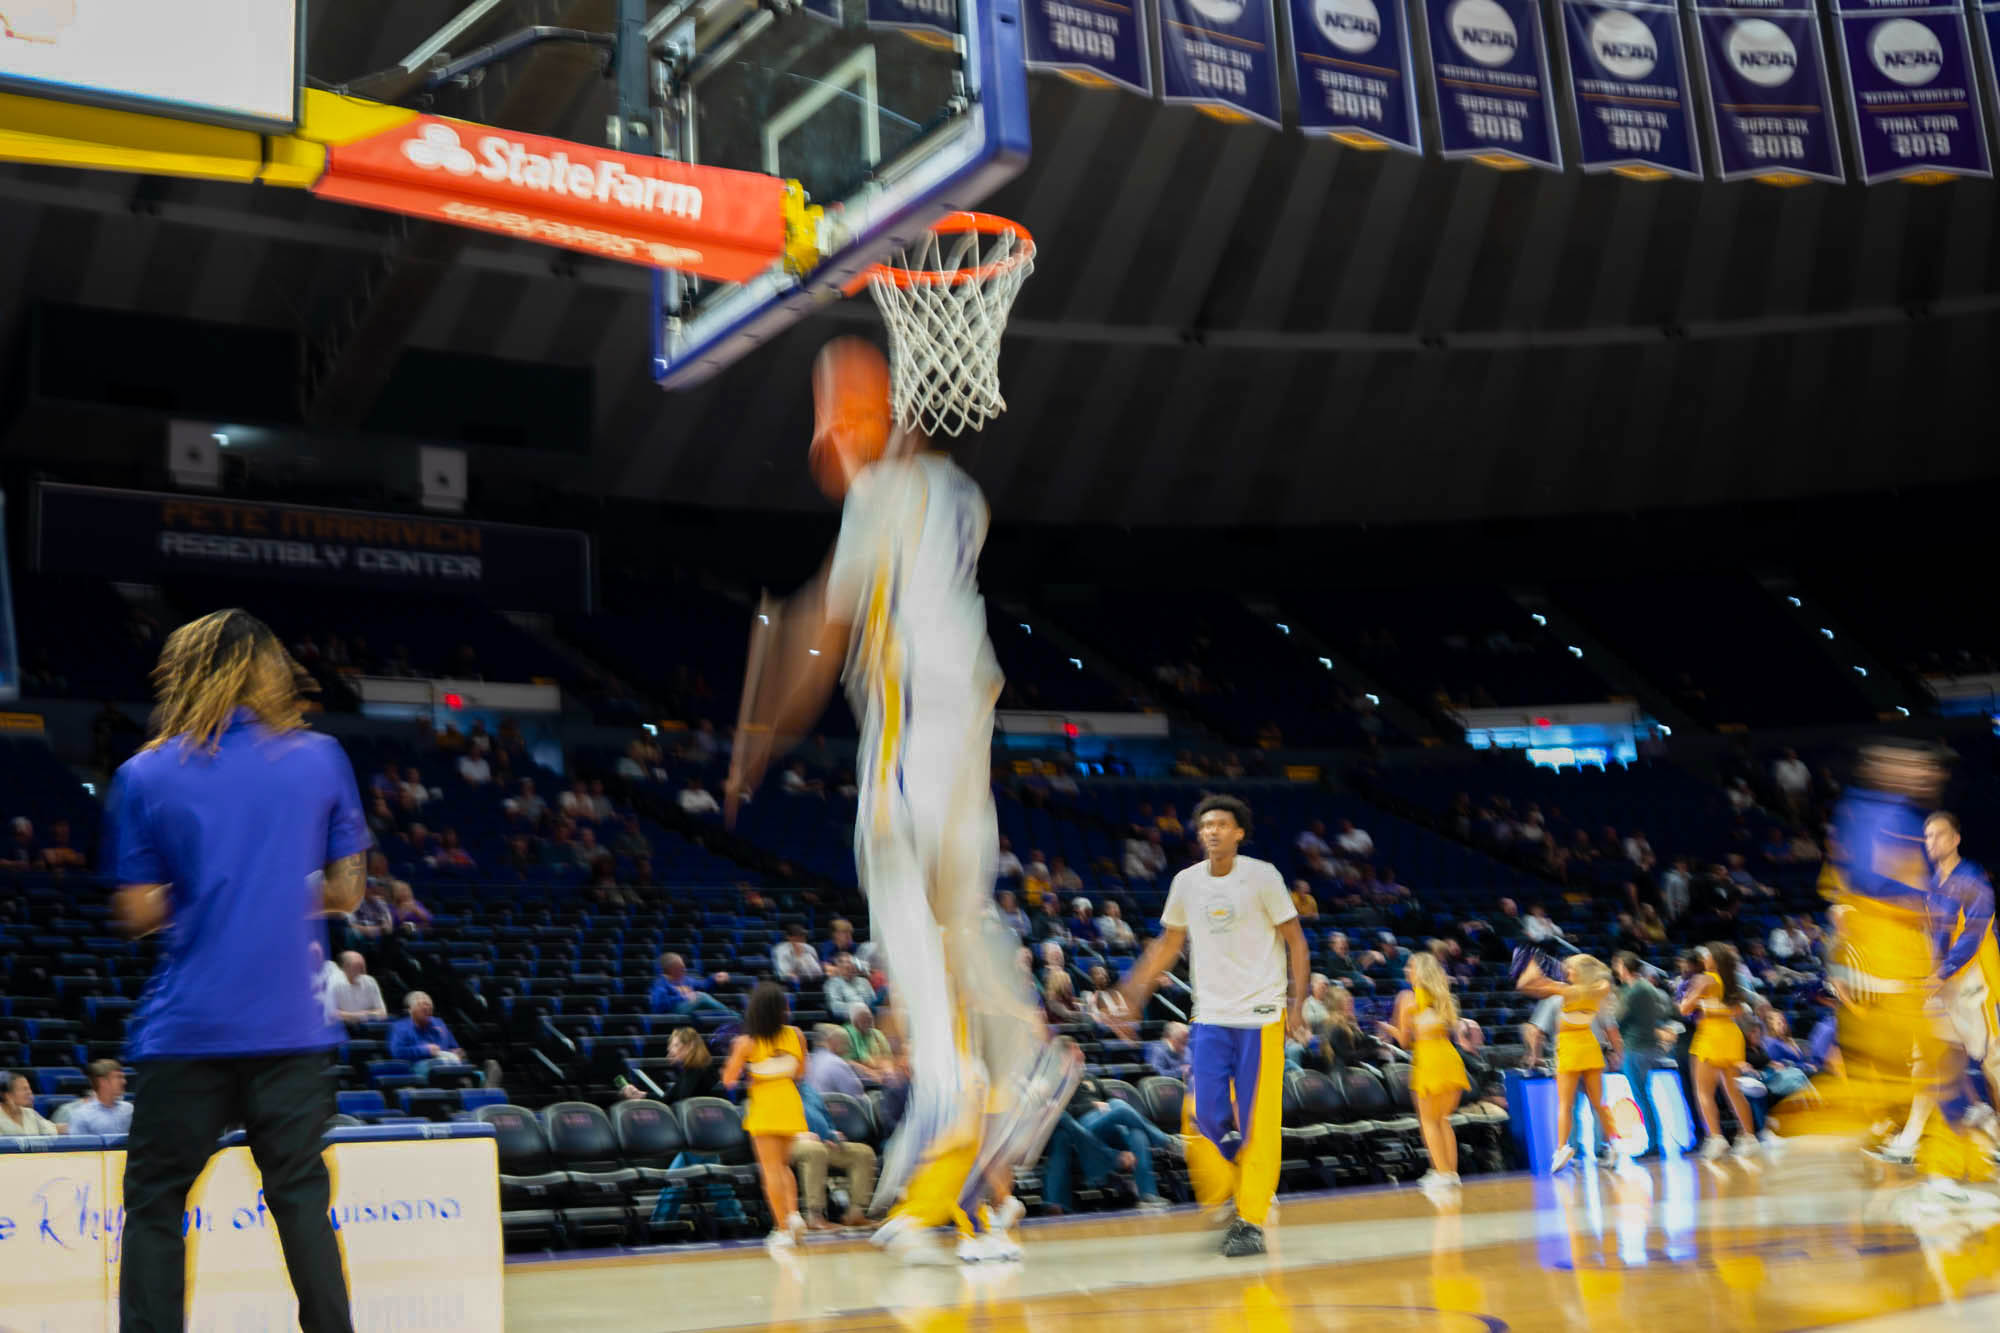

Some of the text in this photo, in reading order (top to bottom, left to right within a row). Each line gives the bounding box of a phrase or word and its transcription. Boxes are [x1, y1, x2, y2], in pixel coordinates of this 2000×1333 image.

[1323, 11, 1380, 37] NCAA
[1461, 25, 1516, 48] NCAA
[1602, 41, 1657, 63] NCAA
[1740, 50, 1796, 68] NCAA
[1883, 50, 1942, 68] NCAA
[1325, 90, 1383, 122] 2014
[1879, 115, 1959, 135] FINAL FOUR
[1608, 125, 1662, 152] 2017
[1892, 133, 1951, 157] 2019
[161, 501, 481, 552] PETE MARAVICH
[160, 530, 482, 580] ASSEMBLY CENTER
[231, 1189, 267, 1231] of
